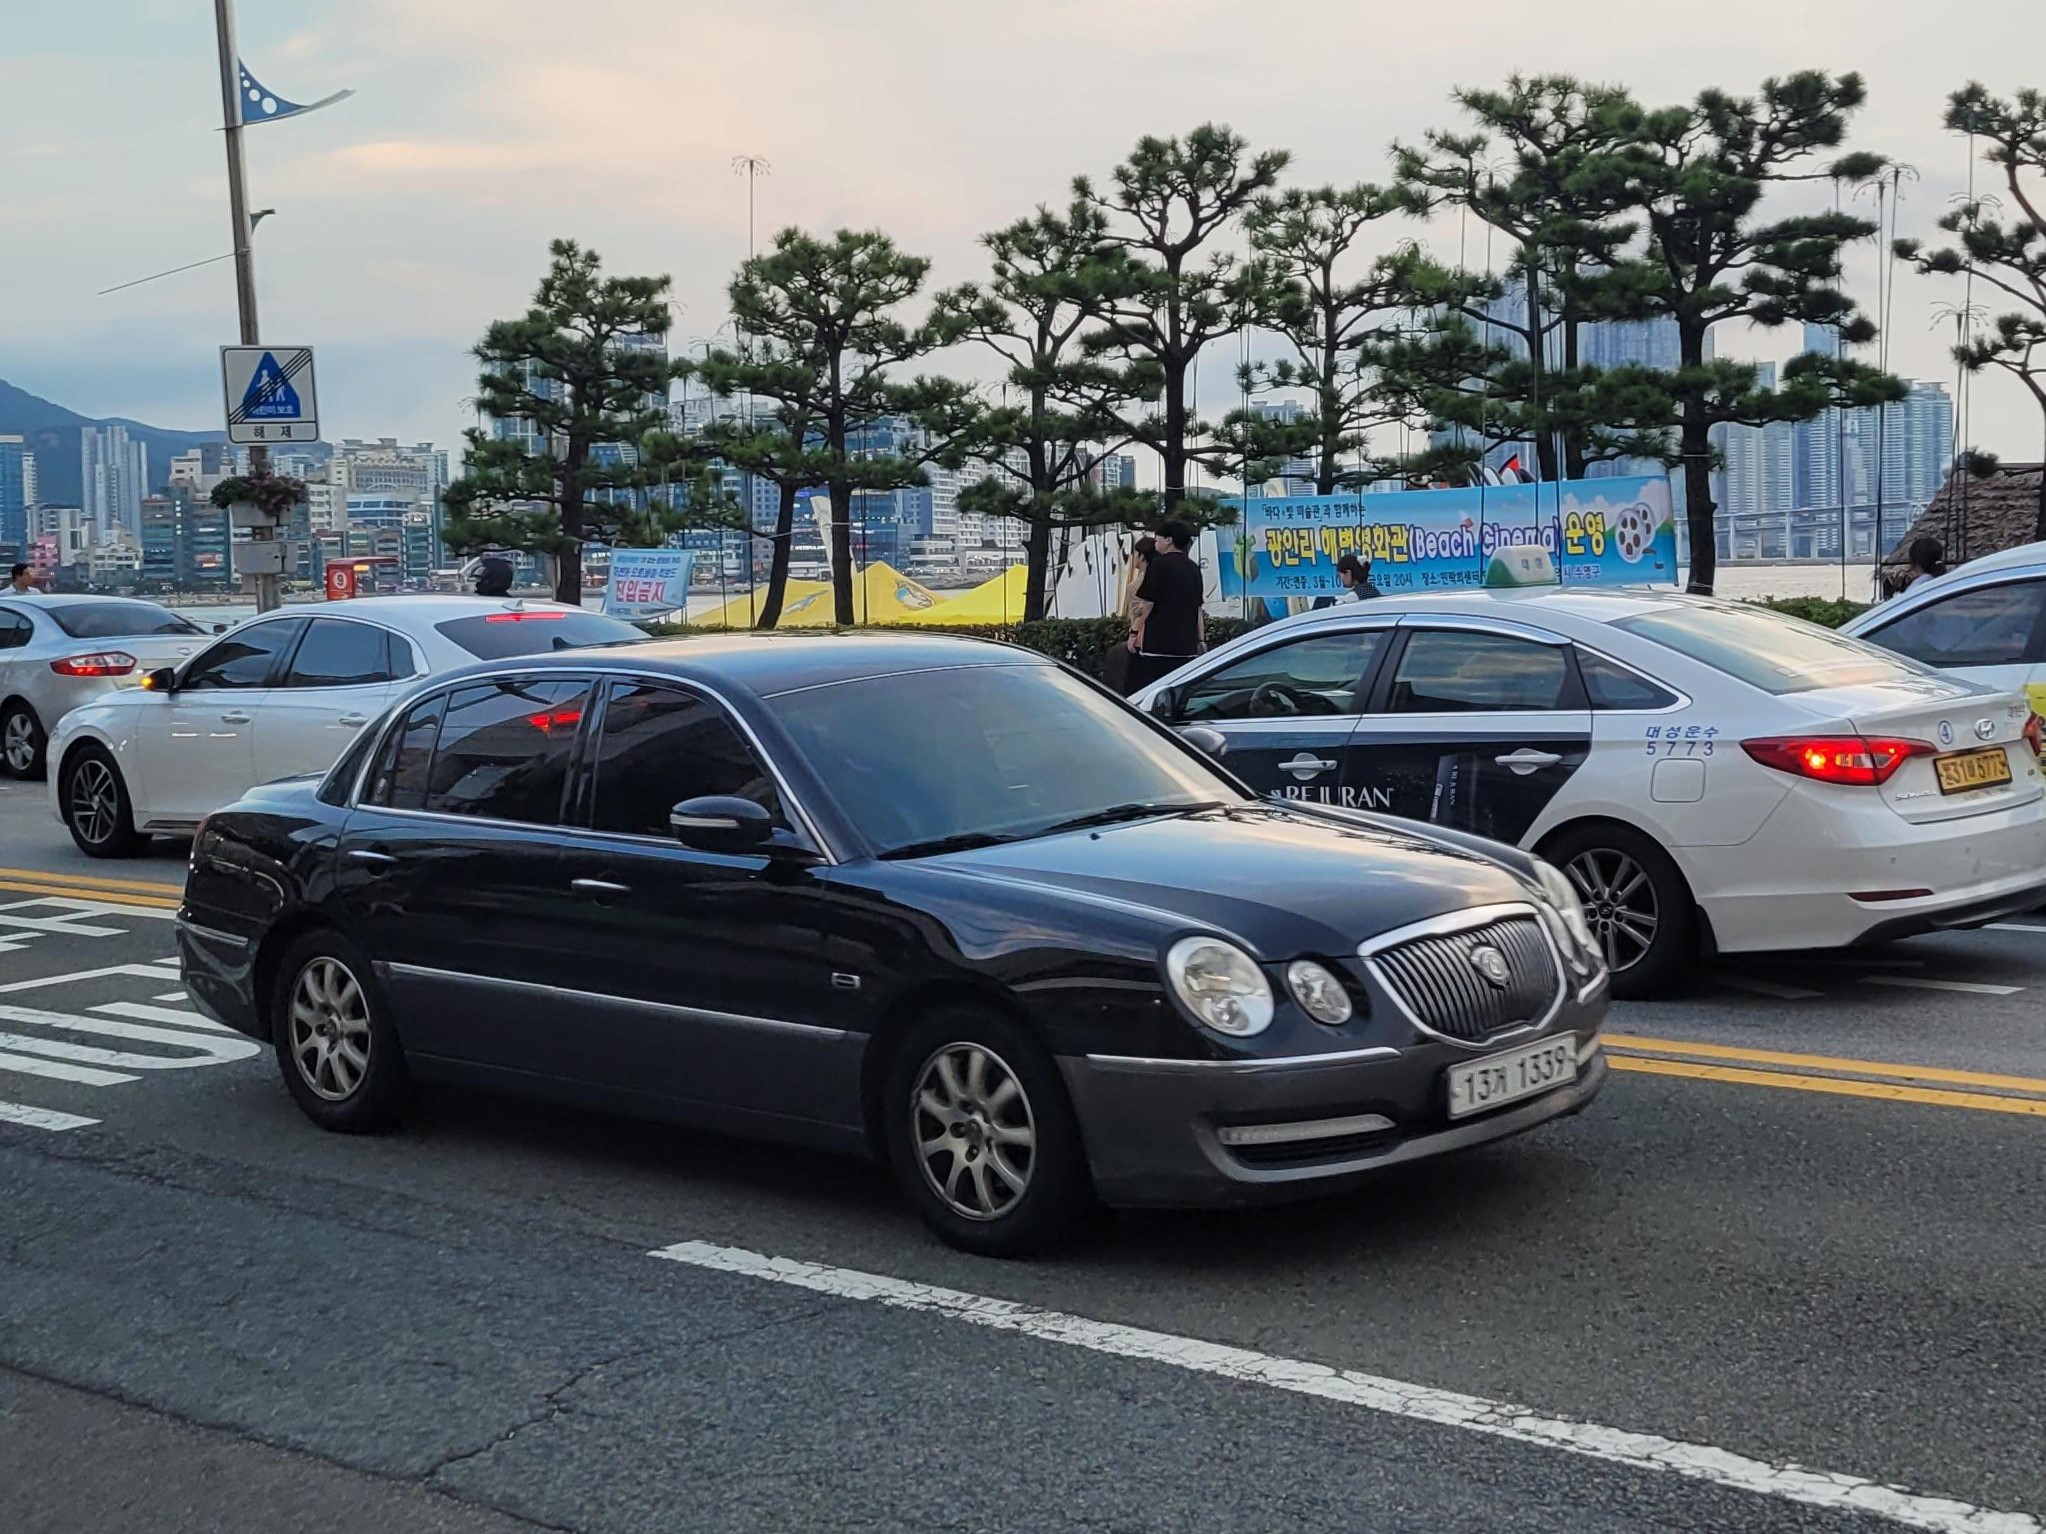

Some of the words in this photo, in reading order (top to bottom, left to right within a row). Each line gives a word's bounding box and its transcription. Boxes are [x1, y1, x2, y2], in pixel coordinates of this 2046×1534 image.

[1265, 527, 1317, 568] 광안리
[1565, 511, 1606, 557] 운영
[336, 573, 345, 587] 9
[616, 580, 667, 603] 진입금지
[1645, 725, 1720, 739] 대성운수
[1646, 740, 1715, 756] 5773
[1517, 1045, 1567, 1089] 1339
